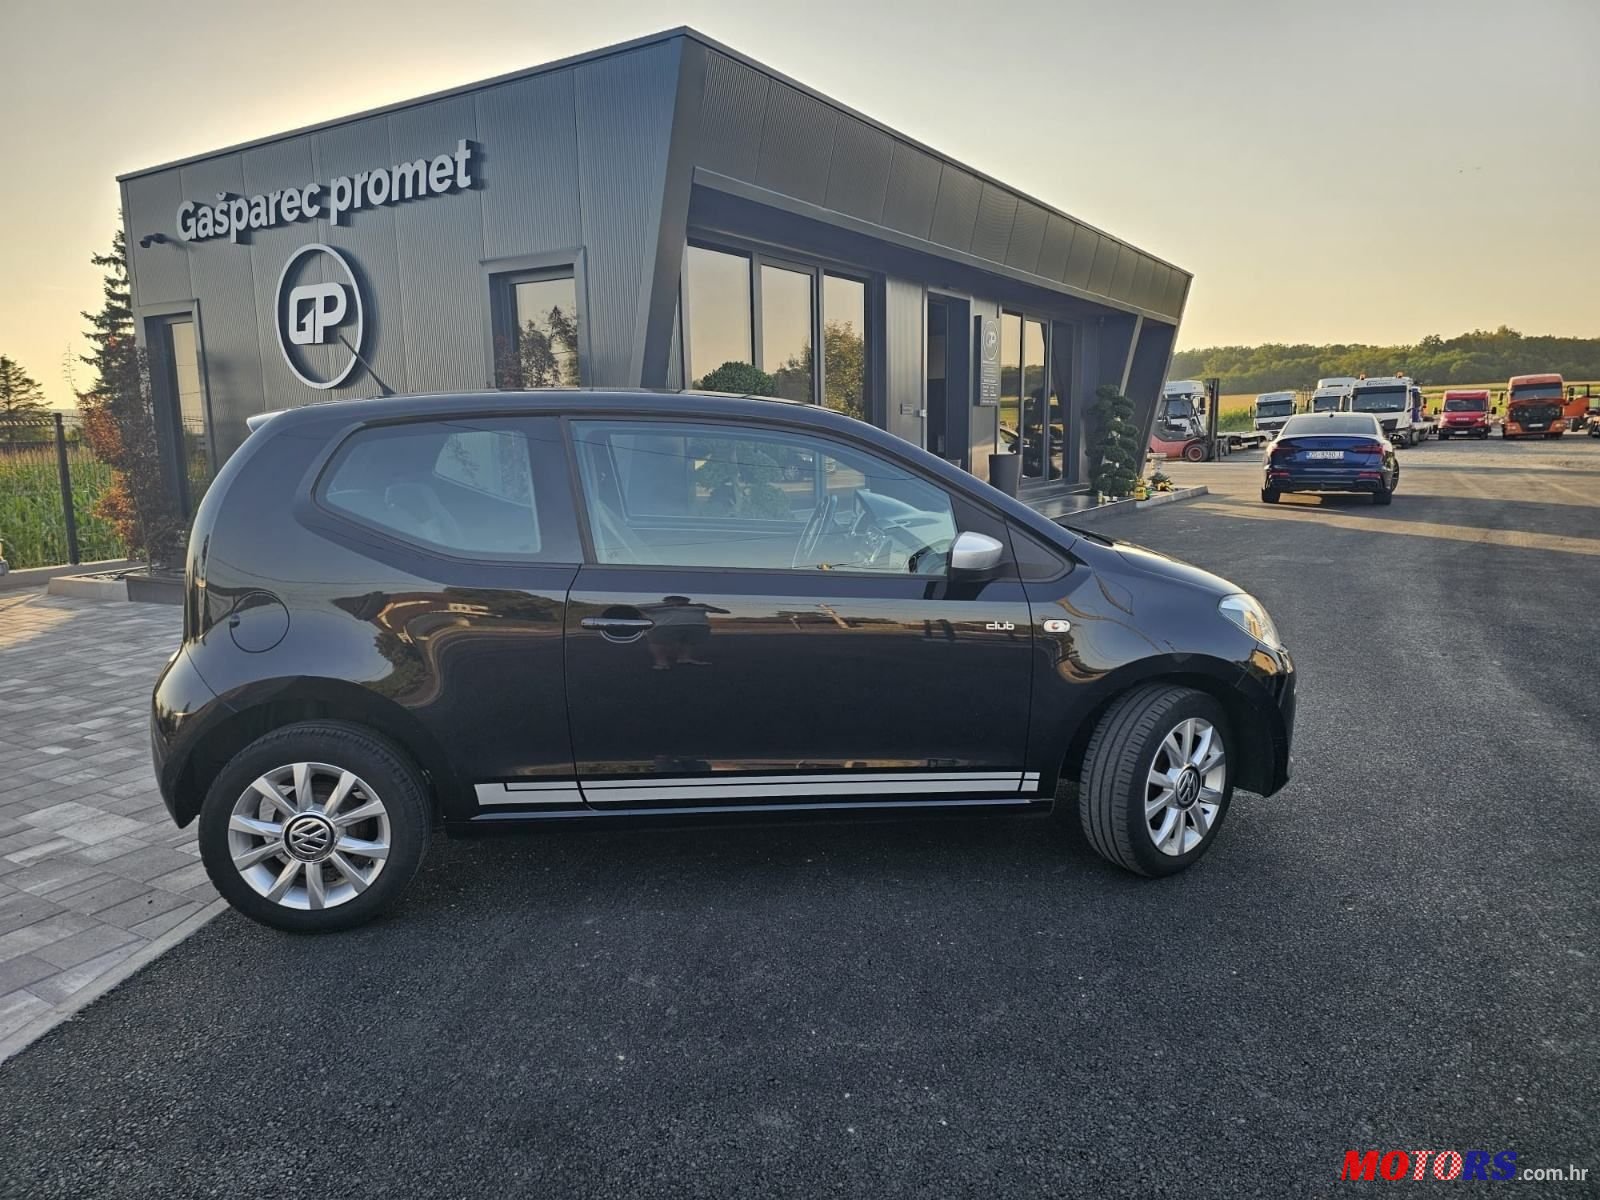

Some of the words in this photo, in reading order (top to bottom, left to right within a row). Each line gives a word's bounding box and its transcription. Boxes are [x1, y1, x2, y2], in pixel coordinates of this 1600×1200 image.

[176, 183, 321, 243] Gašparec
[330, 139, 472, 226] promet
[288, 282, 347, 345] GP
[986, 621, 1015, 630] club
